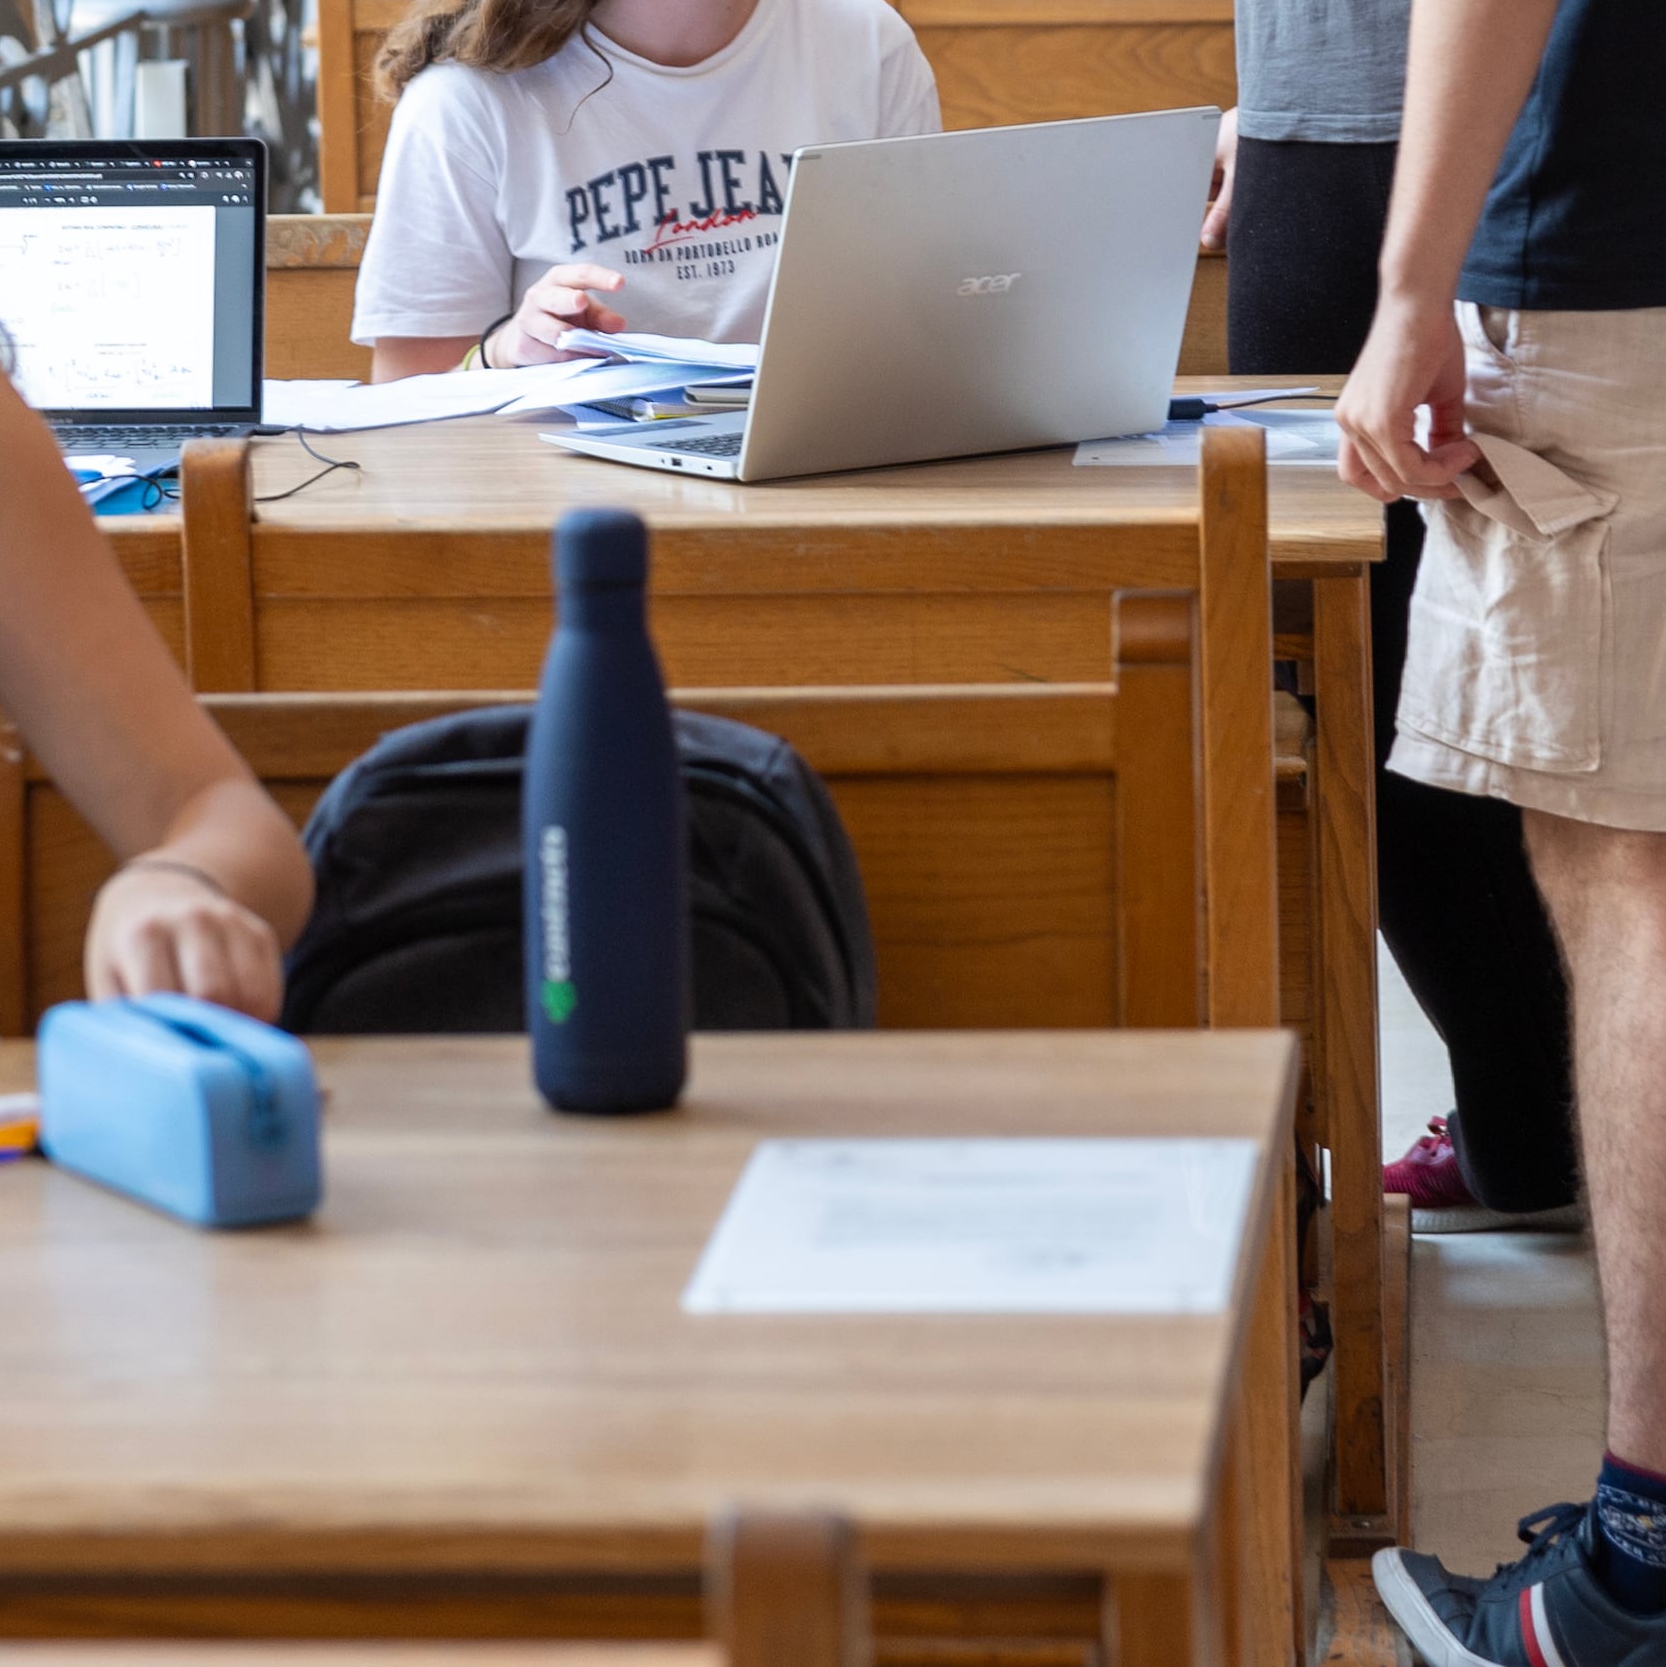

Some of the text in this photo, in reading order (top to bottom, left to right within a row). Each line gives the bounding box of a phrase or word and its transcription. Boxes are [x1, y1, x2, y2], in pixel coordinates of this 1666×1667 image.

[565, 149, 793, 254] PEPE JEA
[647, 207, 760, 248] London
[676, 237, 752, 262] PORTOBELLO
[756, 231, 779, 249] ROA
[676, 260, 735, 280] EST. 1973
[956, 272, 1022, 296] acer
